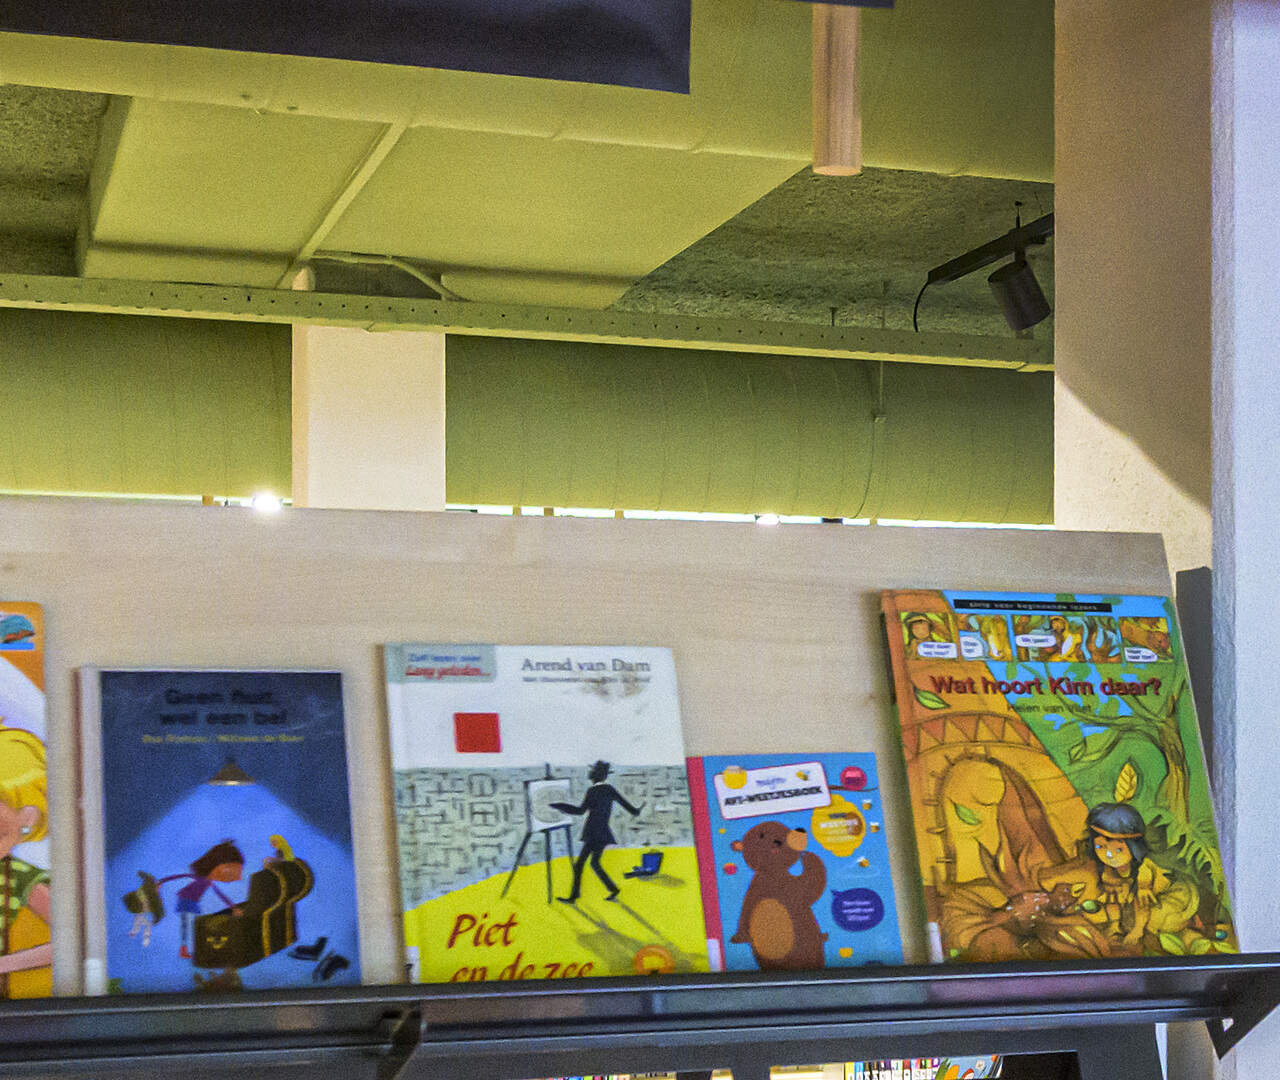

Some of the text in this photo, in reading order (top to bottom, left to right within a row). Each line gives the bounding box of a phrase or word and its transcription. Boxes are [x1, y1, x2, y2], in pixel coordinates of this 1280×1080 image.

[521, 658, 651, 672] Arend van Dam
[929, 675, 1162, 696] Wat hoort Kim daar?
[447, 912, 519, 949] Piet
